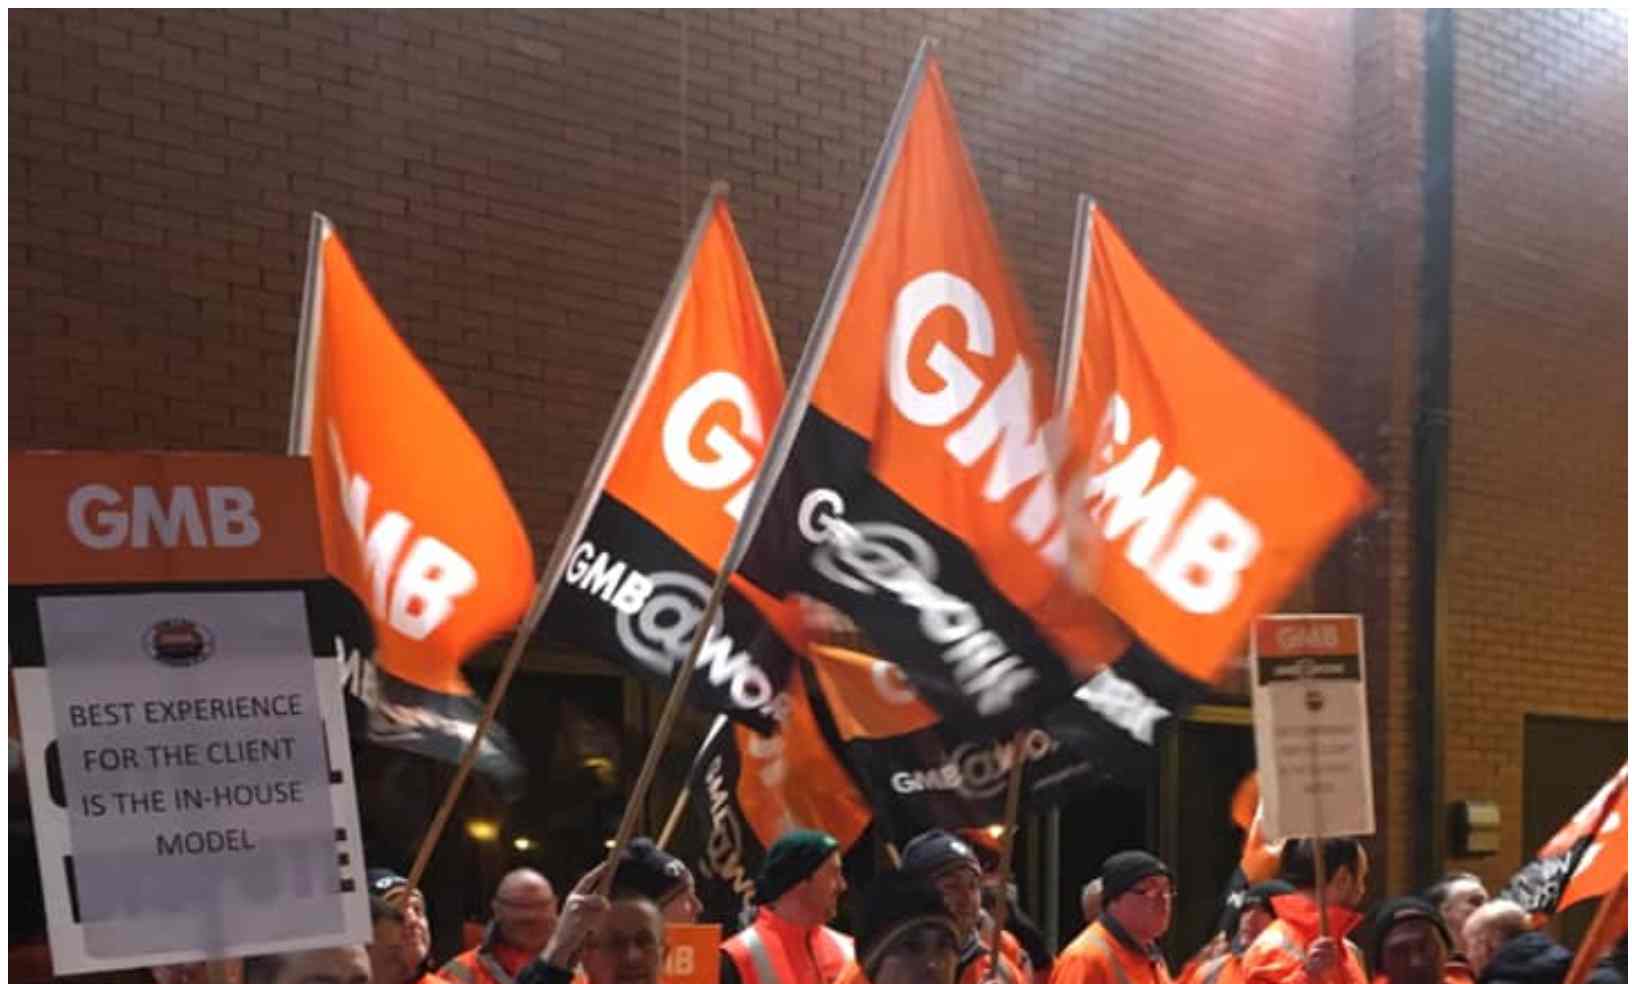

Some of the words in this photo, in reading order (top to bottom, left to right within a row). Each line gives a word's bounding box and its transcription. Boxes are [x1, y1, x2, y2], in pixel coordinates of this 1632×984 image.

[67, 484, 262, 550] GMB
[69, 703, 134, 728] BEST
[143, 694, 304, 724] EXPERIENCE
[83, 747, 139, 772] FOR
[144, 743, 199, 768] THE
[205, 737, 297, 765] CLIENT
[81, 794, 107, 817] IS
[111, 788, 168, 814] THE
[173, 781, 304, 810] IN-HOUSE
[155, 828, 255, 856] MODEL
